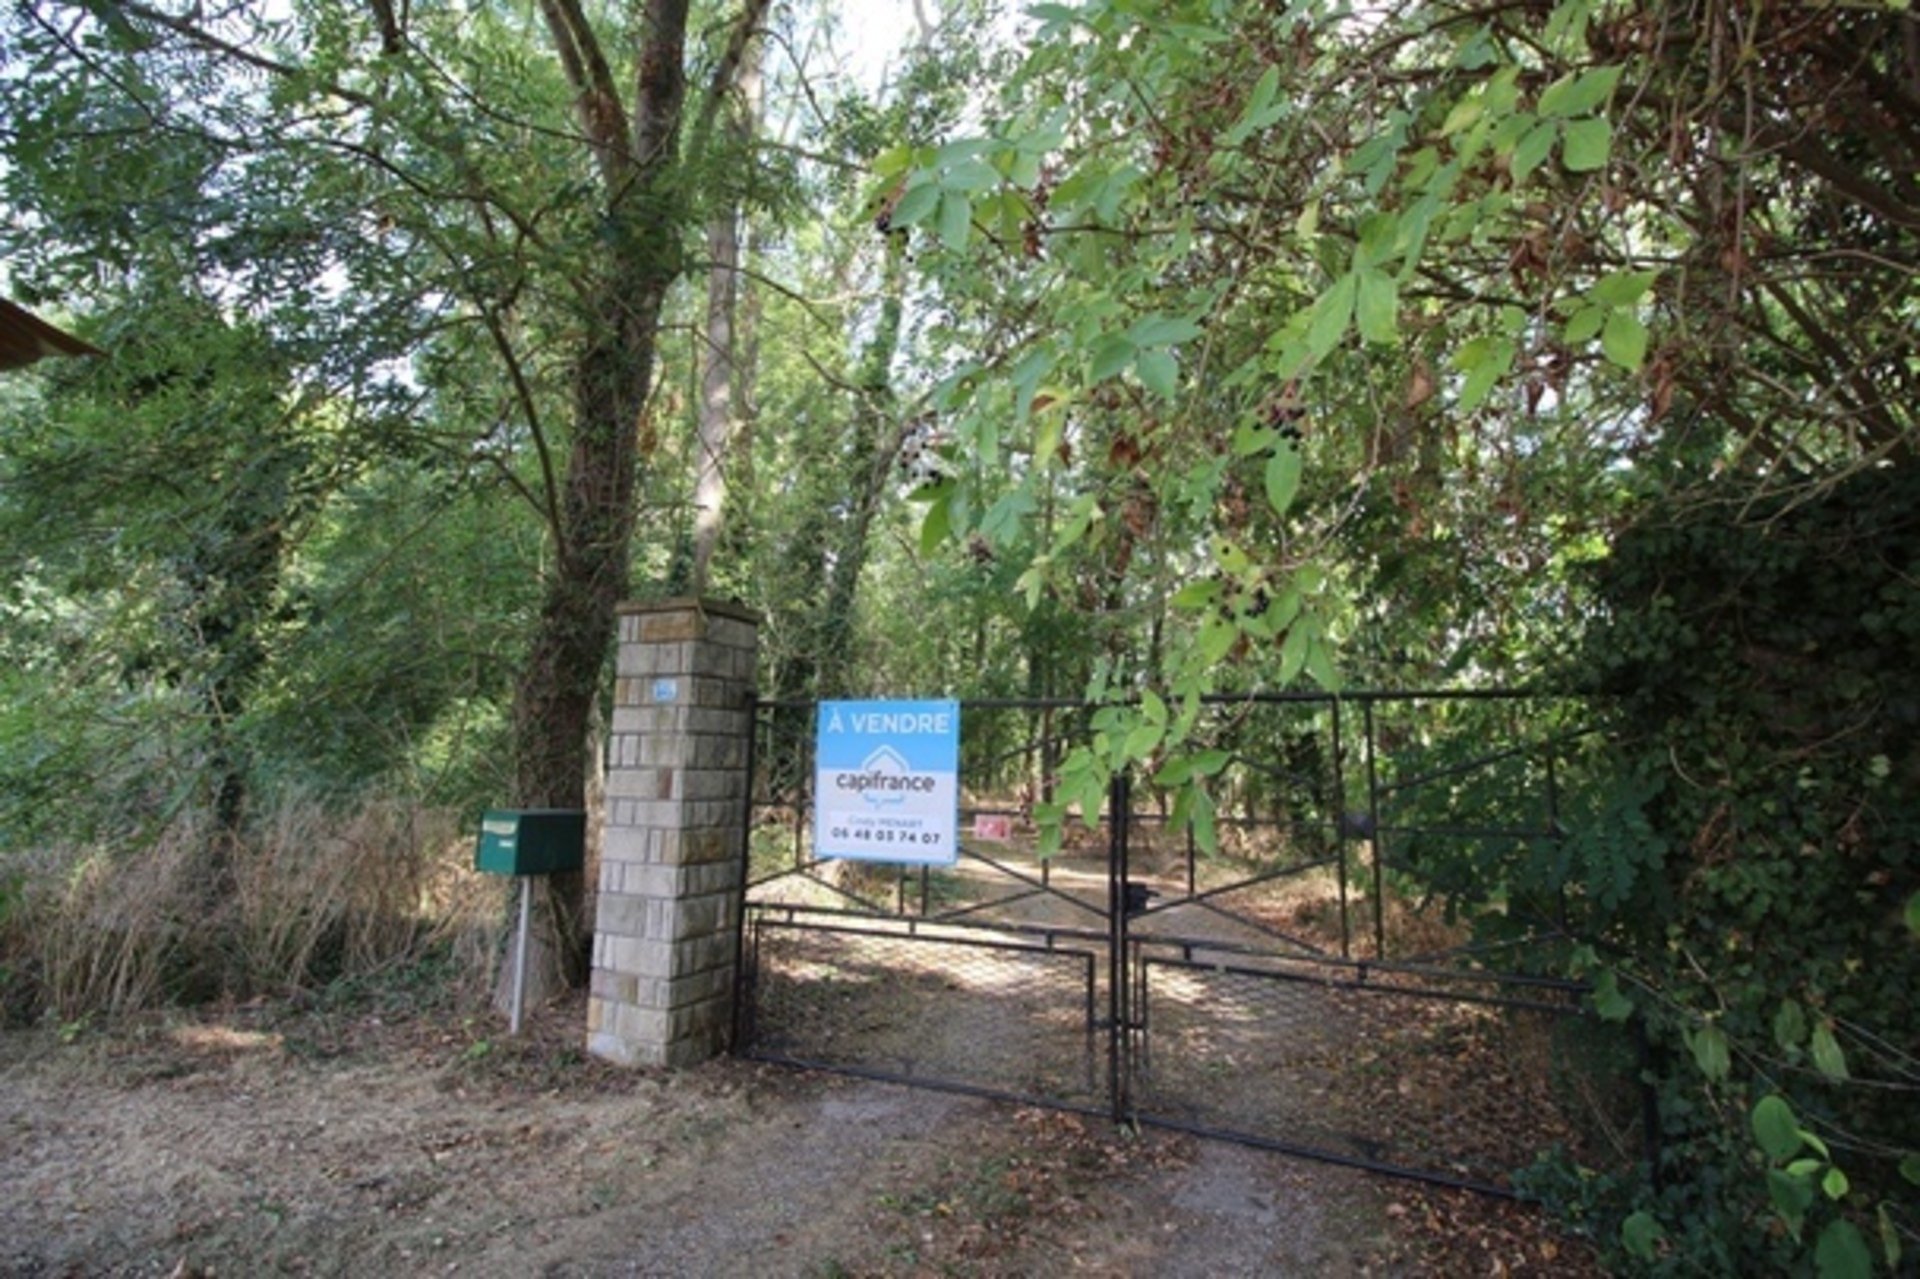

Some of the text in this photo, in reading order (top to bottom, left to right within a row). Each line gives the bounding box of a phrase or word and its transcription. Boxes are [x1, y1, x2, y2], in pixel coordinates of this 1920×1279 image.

[851, 713, 950, 734] VENDRE
[836, 770, 935, 793] capifrance
[922, 833, 941, 844] 07
